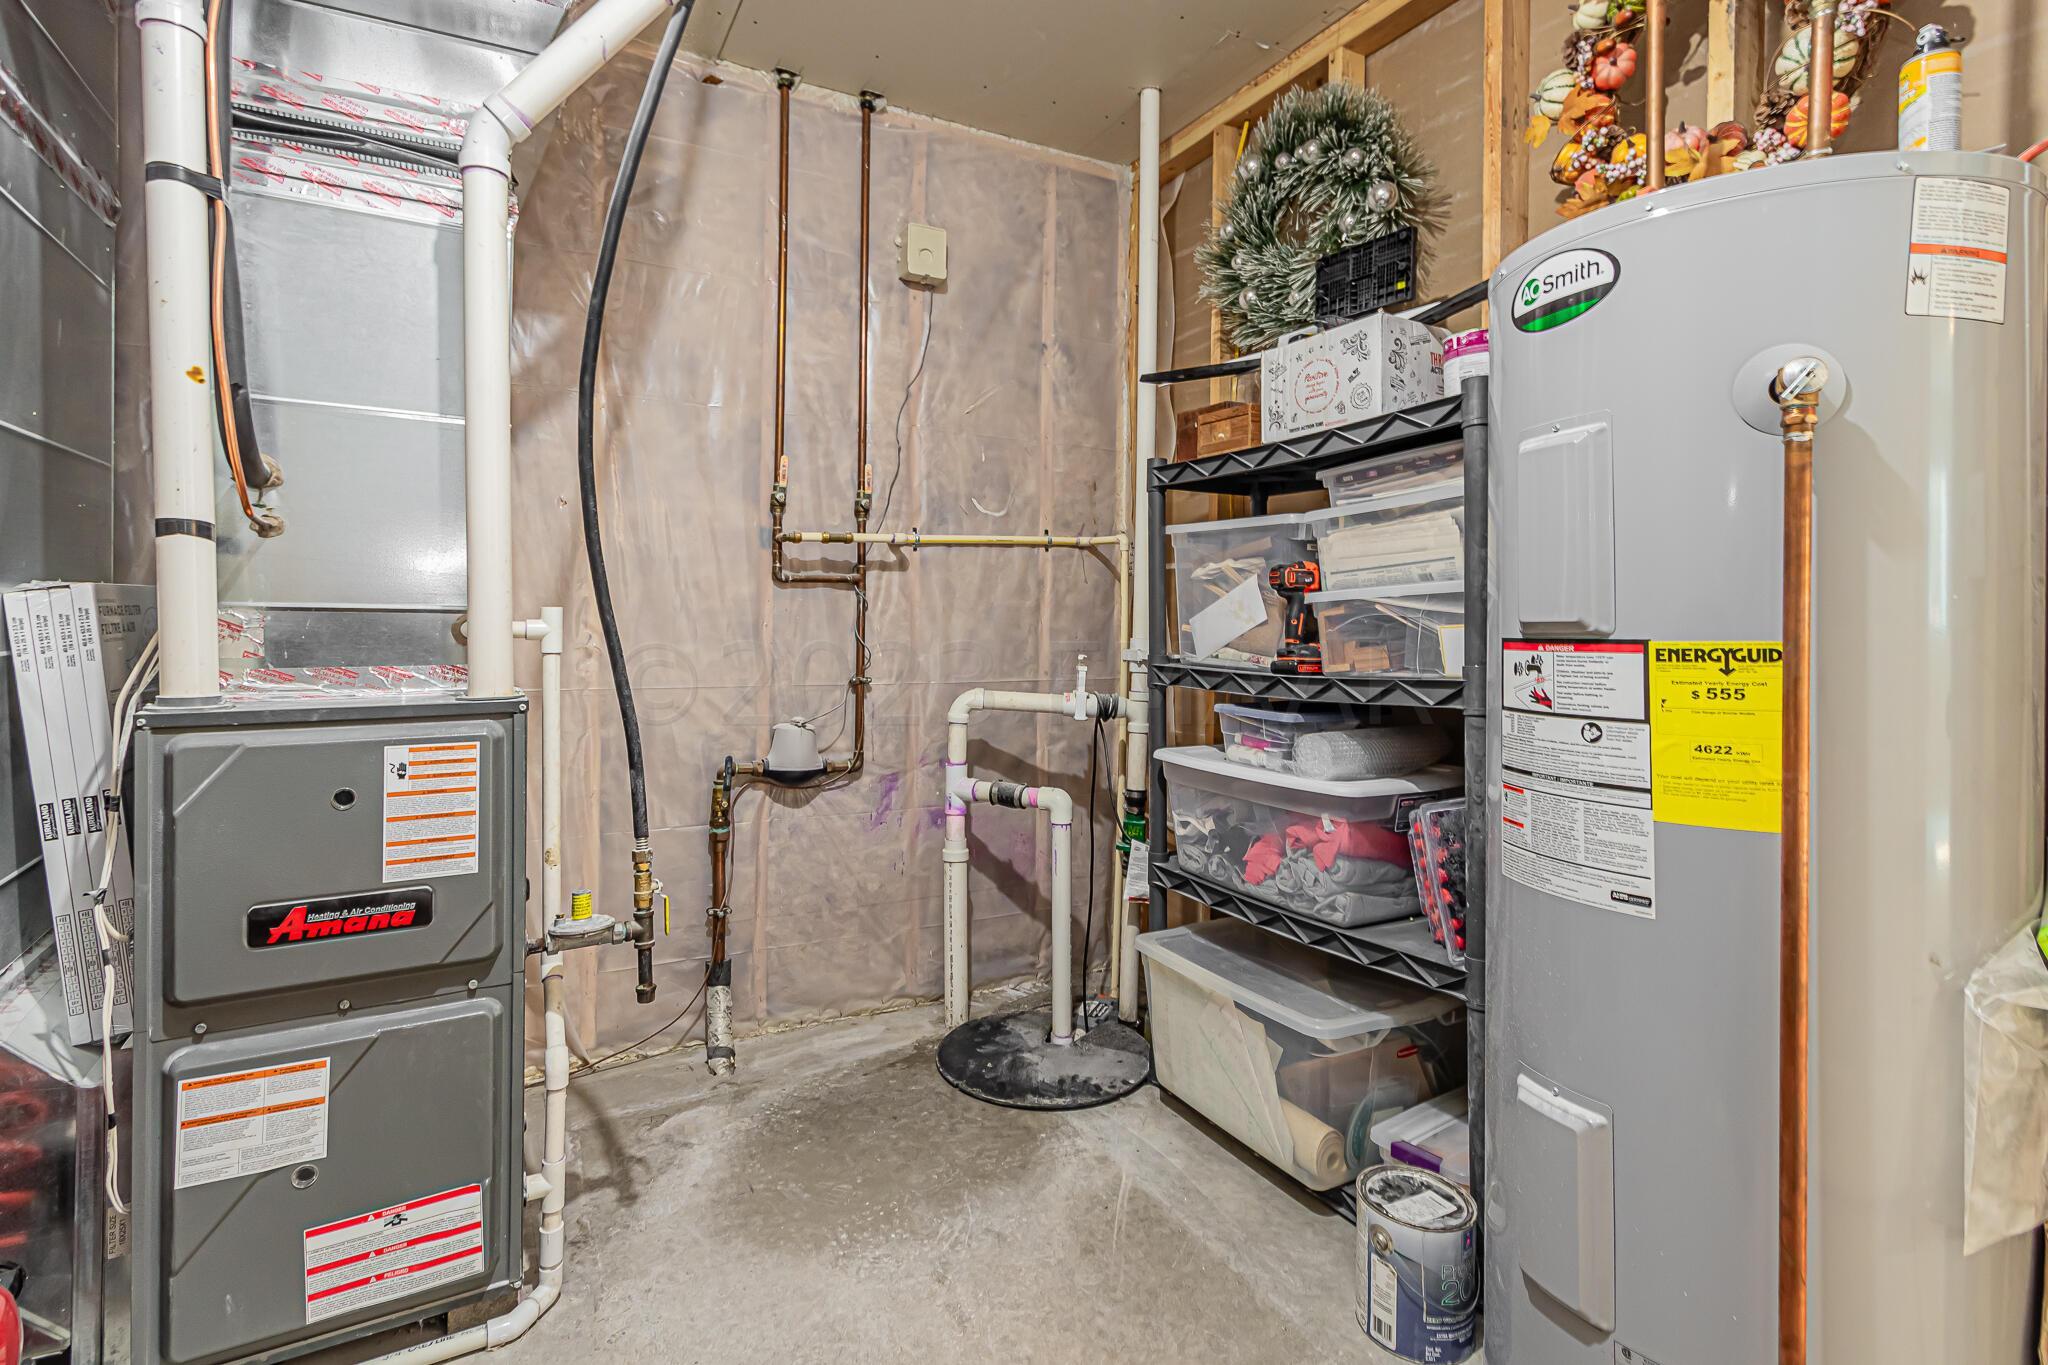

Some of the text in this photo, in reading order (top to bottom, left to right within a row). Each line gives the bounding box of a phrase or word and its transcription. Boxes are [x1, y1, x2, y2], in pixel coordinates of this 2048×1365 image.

[1543, 260, 1600, 294] Smith
[1545, 644, 1574, 652] DANGER
[1692, 688, 1746, 700] $ 555
[1694, 744, 1732, 755] 4622
[41, 805, 53, 839] KIRKLAND
[63, 800, 75, 834] KIRKLAND
[86, 798, 96, 831] KIRKLAND
[307, 912, 340, 923] Heating
[350, 907, 363, 916] Air
[365, 902, 416, 914] Conditioning
[266, 906, 416, 944] Amana
[382, 1205, 407, 1216] DANGER
[383, 1242, 408, 1254] DANGER
